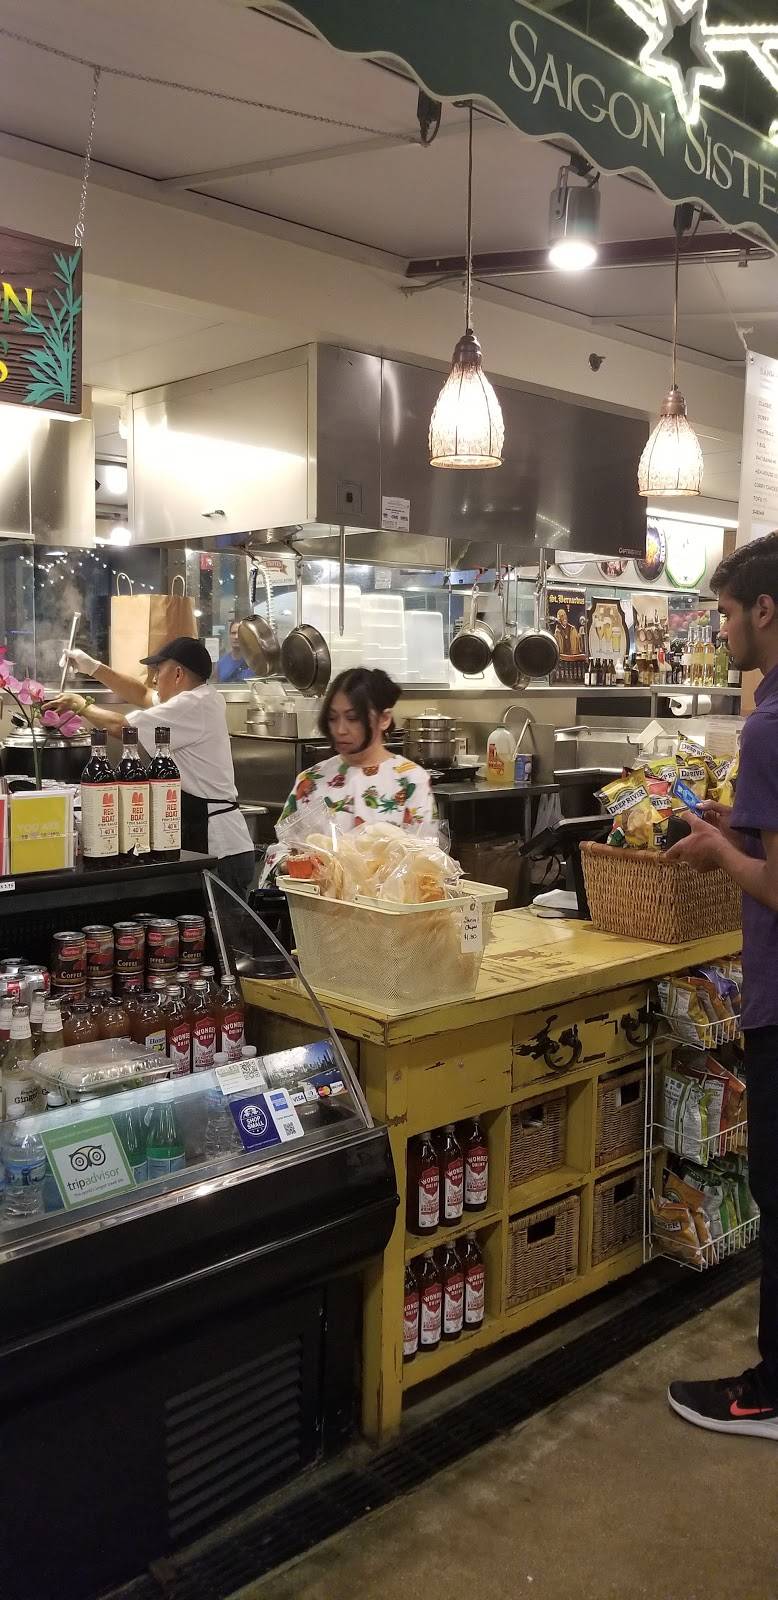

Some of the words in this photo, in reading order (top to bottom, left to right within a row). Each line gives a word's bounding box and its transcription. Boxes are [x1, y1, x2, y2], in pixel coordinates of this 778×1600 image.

[508, 20, 666, 157] SAIGON
[166, 803, 177, 811] RED
[609, 800, 626, 814] DEEP
[626, 789, 645, 803] RIVER
[246, 1116, 261, 1125] SHOP
[247, 1121, 264, 1131] SMALL
[67, 1167, 121, 1191] tripadvisor
